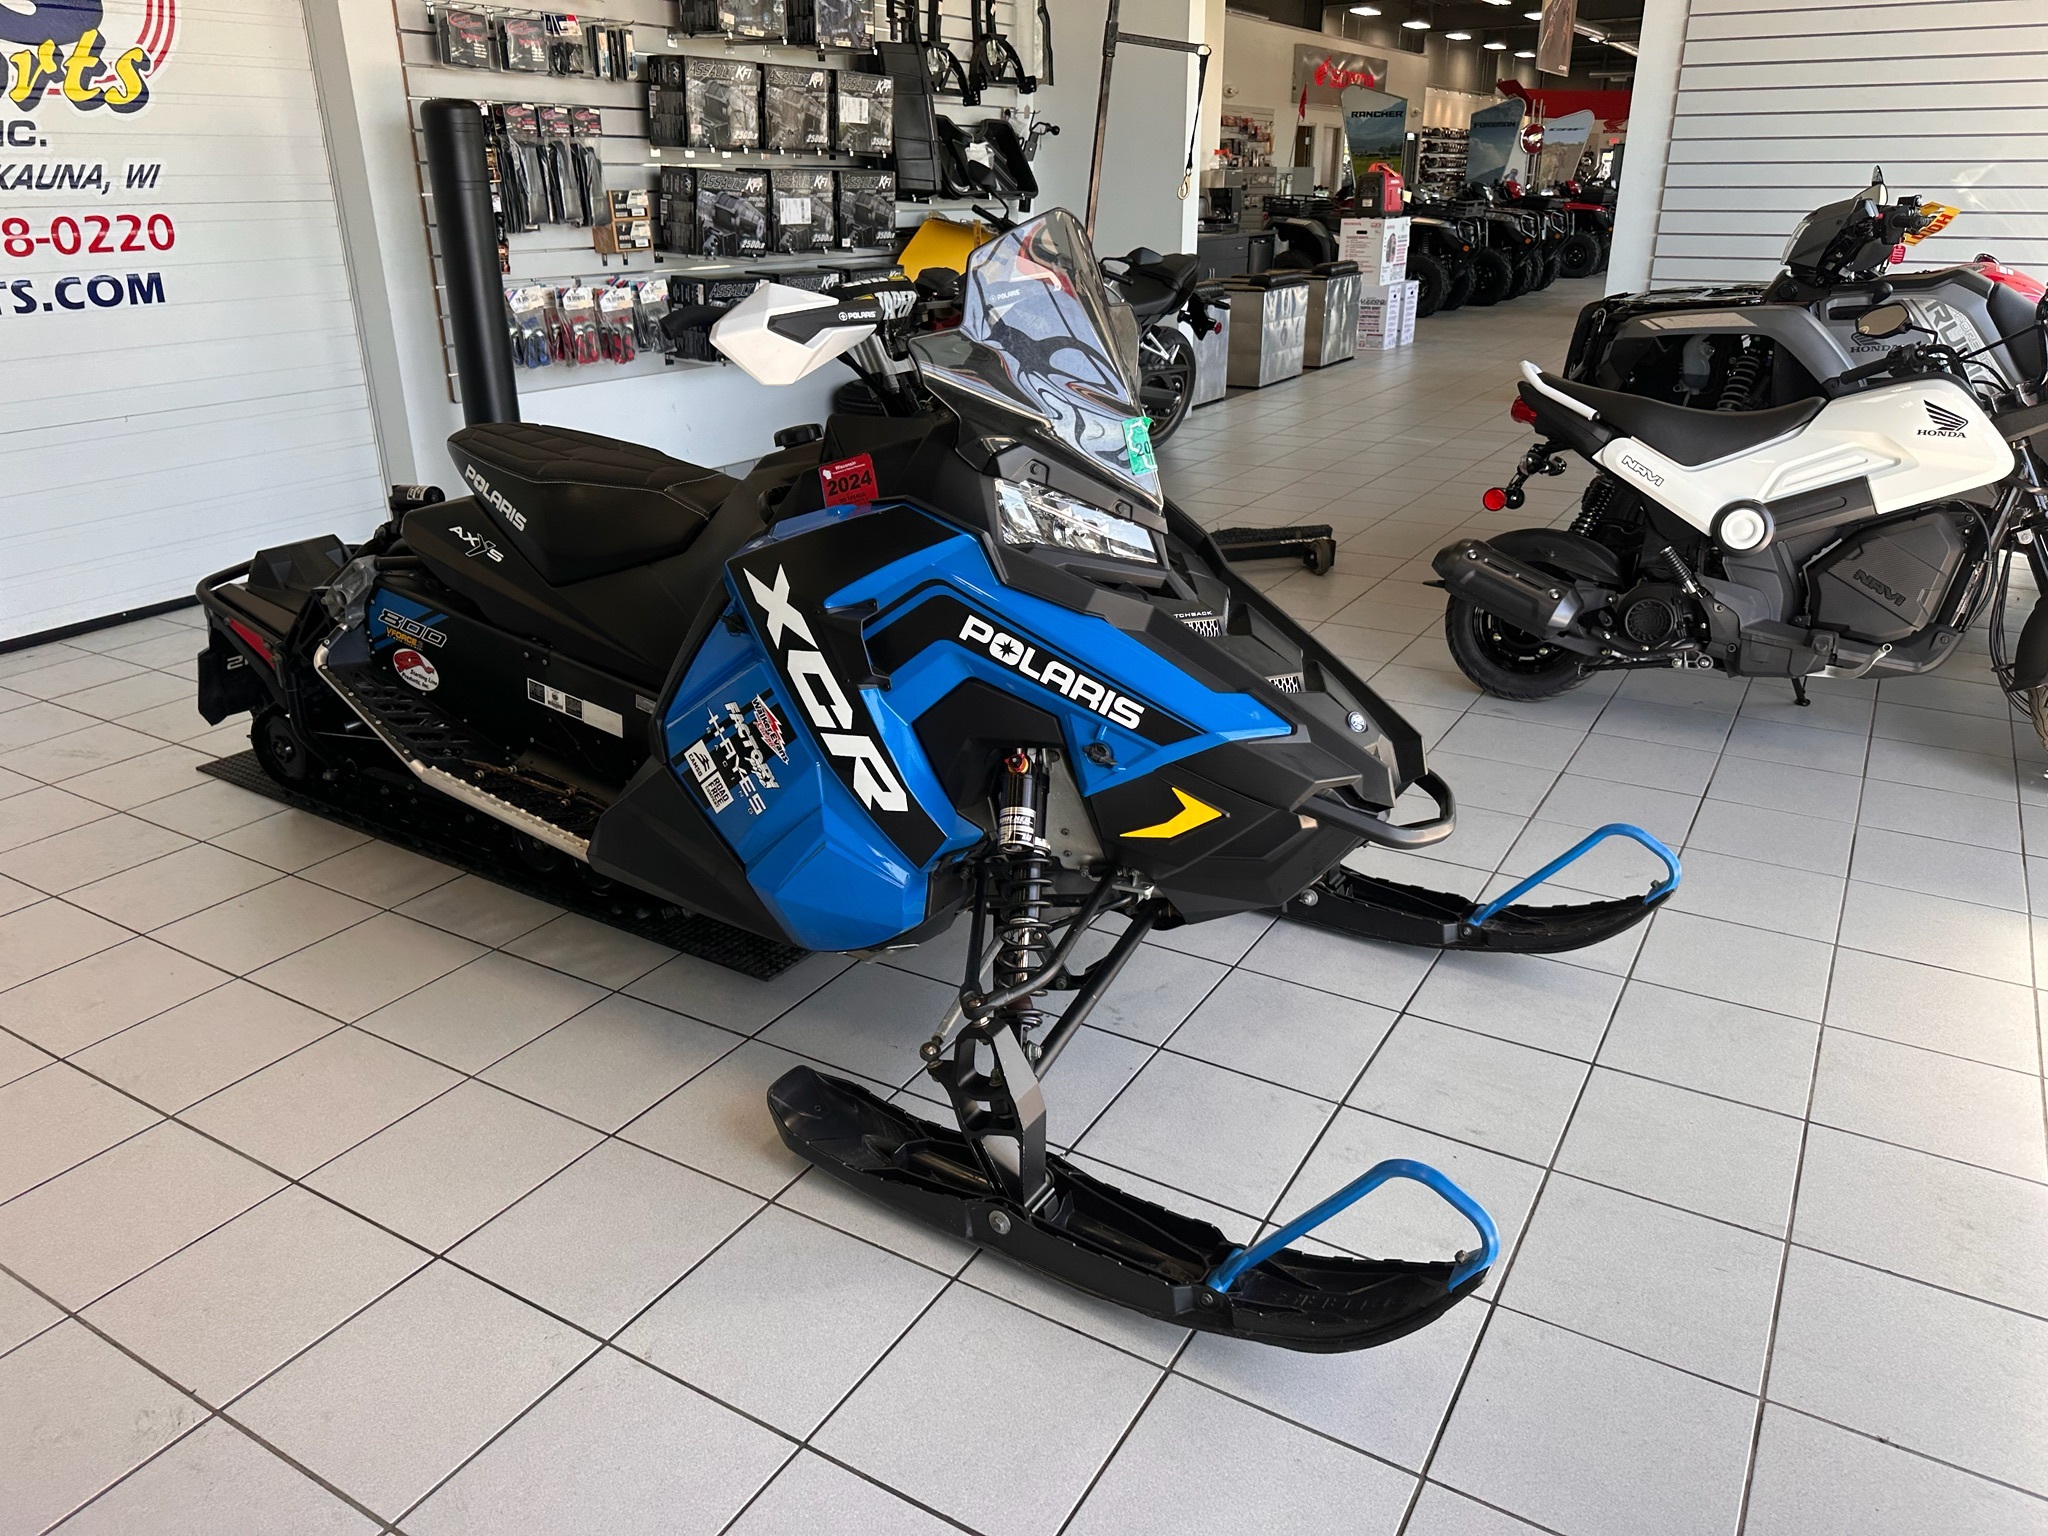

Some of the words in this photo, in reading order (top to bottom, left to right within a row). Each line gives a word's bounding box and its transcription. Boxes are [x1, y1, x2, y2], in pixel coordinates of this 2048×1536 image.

[0, 28, 151, 113] rts
[687, 60, 735, 79] ASSAULT
[767, 68, 810, 86] ASSAULT
[1351, 110, 1404, 118] RANCHER
[1473, 121, 1516, 129] FOREMAN
[126, 163, 161, 189] WI
[699, 172, 746, 190] ASSAULT
[773, 172, 814, 189] ASSAULT
[842, 174, 879, 190] ASSAULT
[1, 214, 176, 257] 8-0220
[741, 239, 765, 249] 2500LB
[709, 281, 754, 298] ASSAULT
[783, 277, 822, 291] ASSAULT
[997, 289, 1021, 301] POLARIS
[848, 311, 876, 320] POLARIS
[874, 290, 918, 321] TAPER
[1916, 429, 1967, 438] HONDA
[835, 461, 857, 470] Wisconsin
[1621, 455, 1665, 487] NAVI
[827, 470, 872, 497] 2024
[465, 464, 527, 532] POLARIS
[448, 526, 504, 563] AXYS
[1852, 569, 1907, 607] NAVI
[378, 608, 447, 648] 800
[410, 669, 428, 682] Starting
[959, 614, 1145, 730] POLARIS
[743, 563, 908, 812] XCR
[724, 701, 780, 788] FACTORY
[688, 753, 703, 777] CAMSO
[705, 703, 767, 815] HAYES
[707, 781, 725, 805] FREE
[713, 777, 730, 802] ROAD
